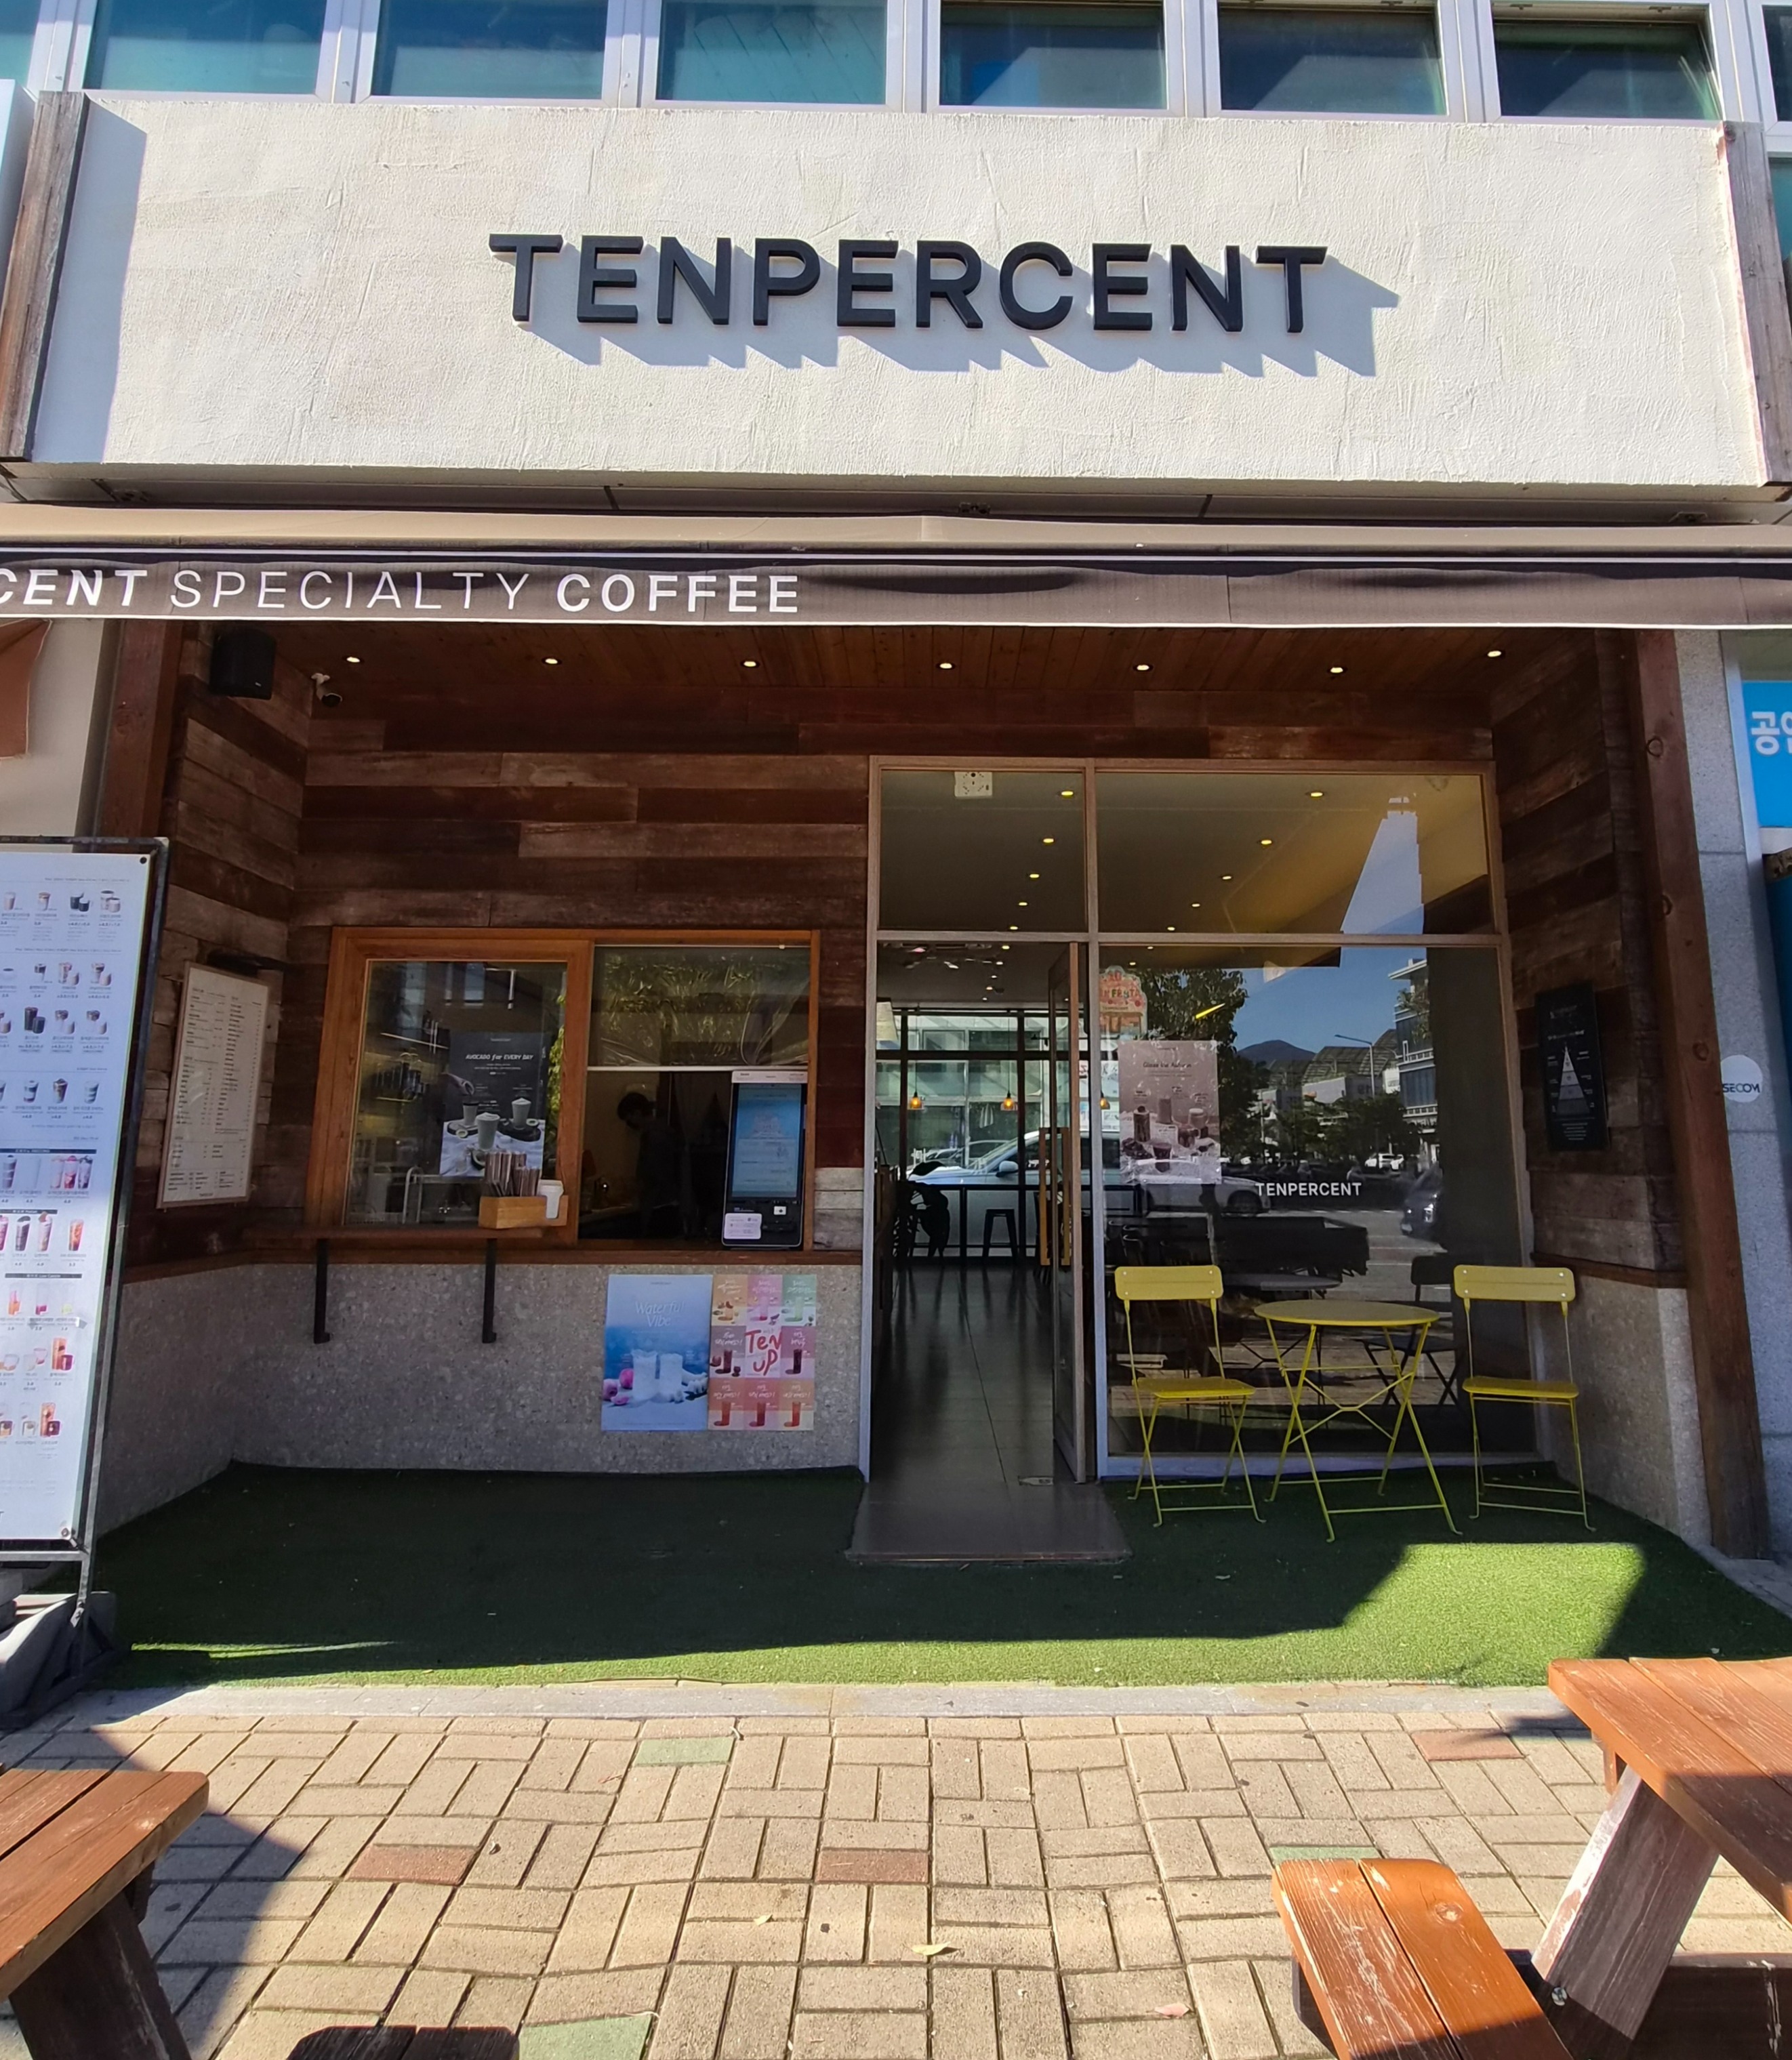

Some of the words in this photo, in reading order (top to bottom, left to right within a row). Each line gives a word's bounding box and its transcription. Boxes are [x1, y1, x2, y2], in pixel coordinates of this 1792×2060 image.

[489, 233, 1328, 334] TENPERCENT
[169, 570, 529, 611] SPECIALTY
[556, 573, 798, 613] COFFEE
[1722, 1083, 1760, 1093] SECOM
[1255, 1182, 1362, 1196] TENPERCENT
